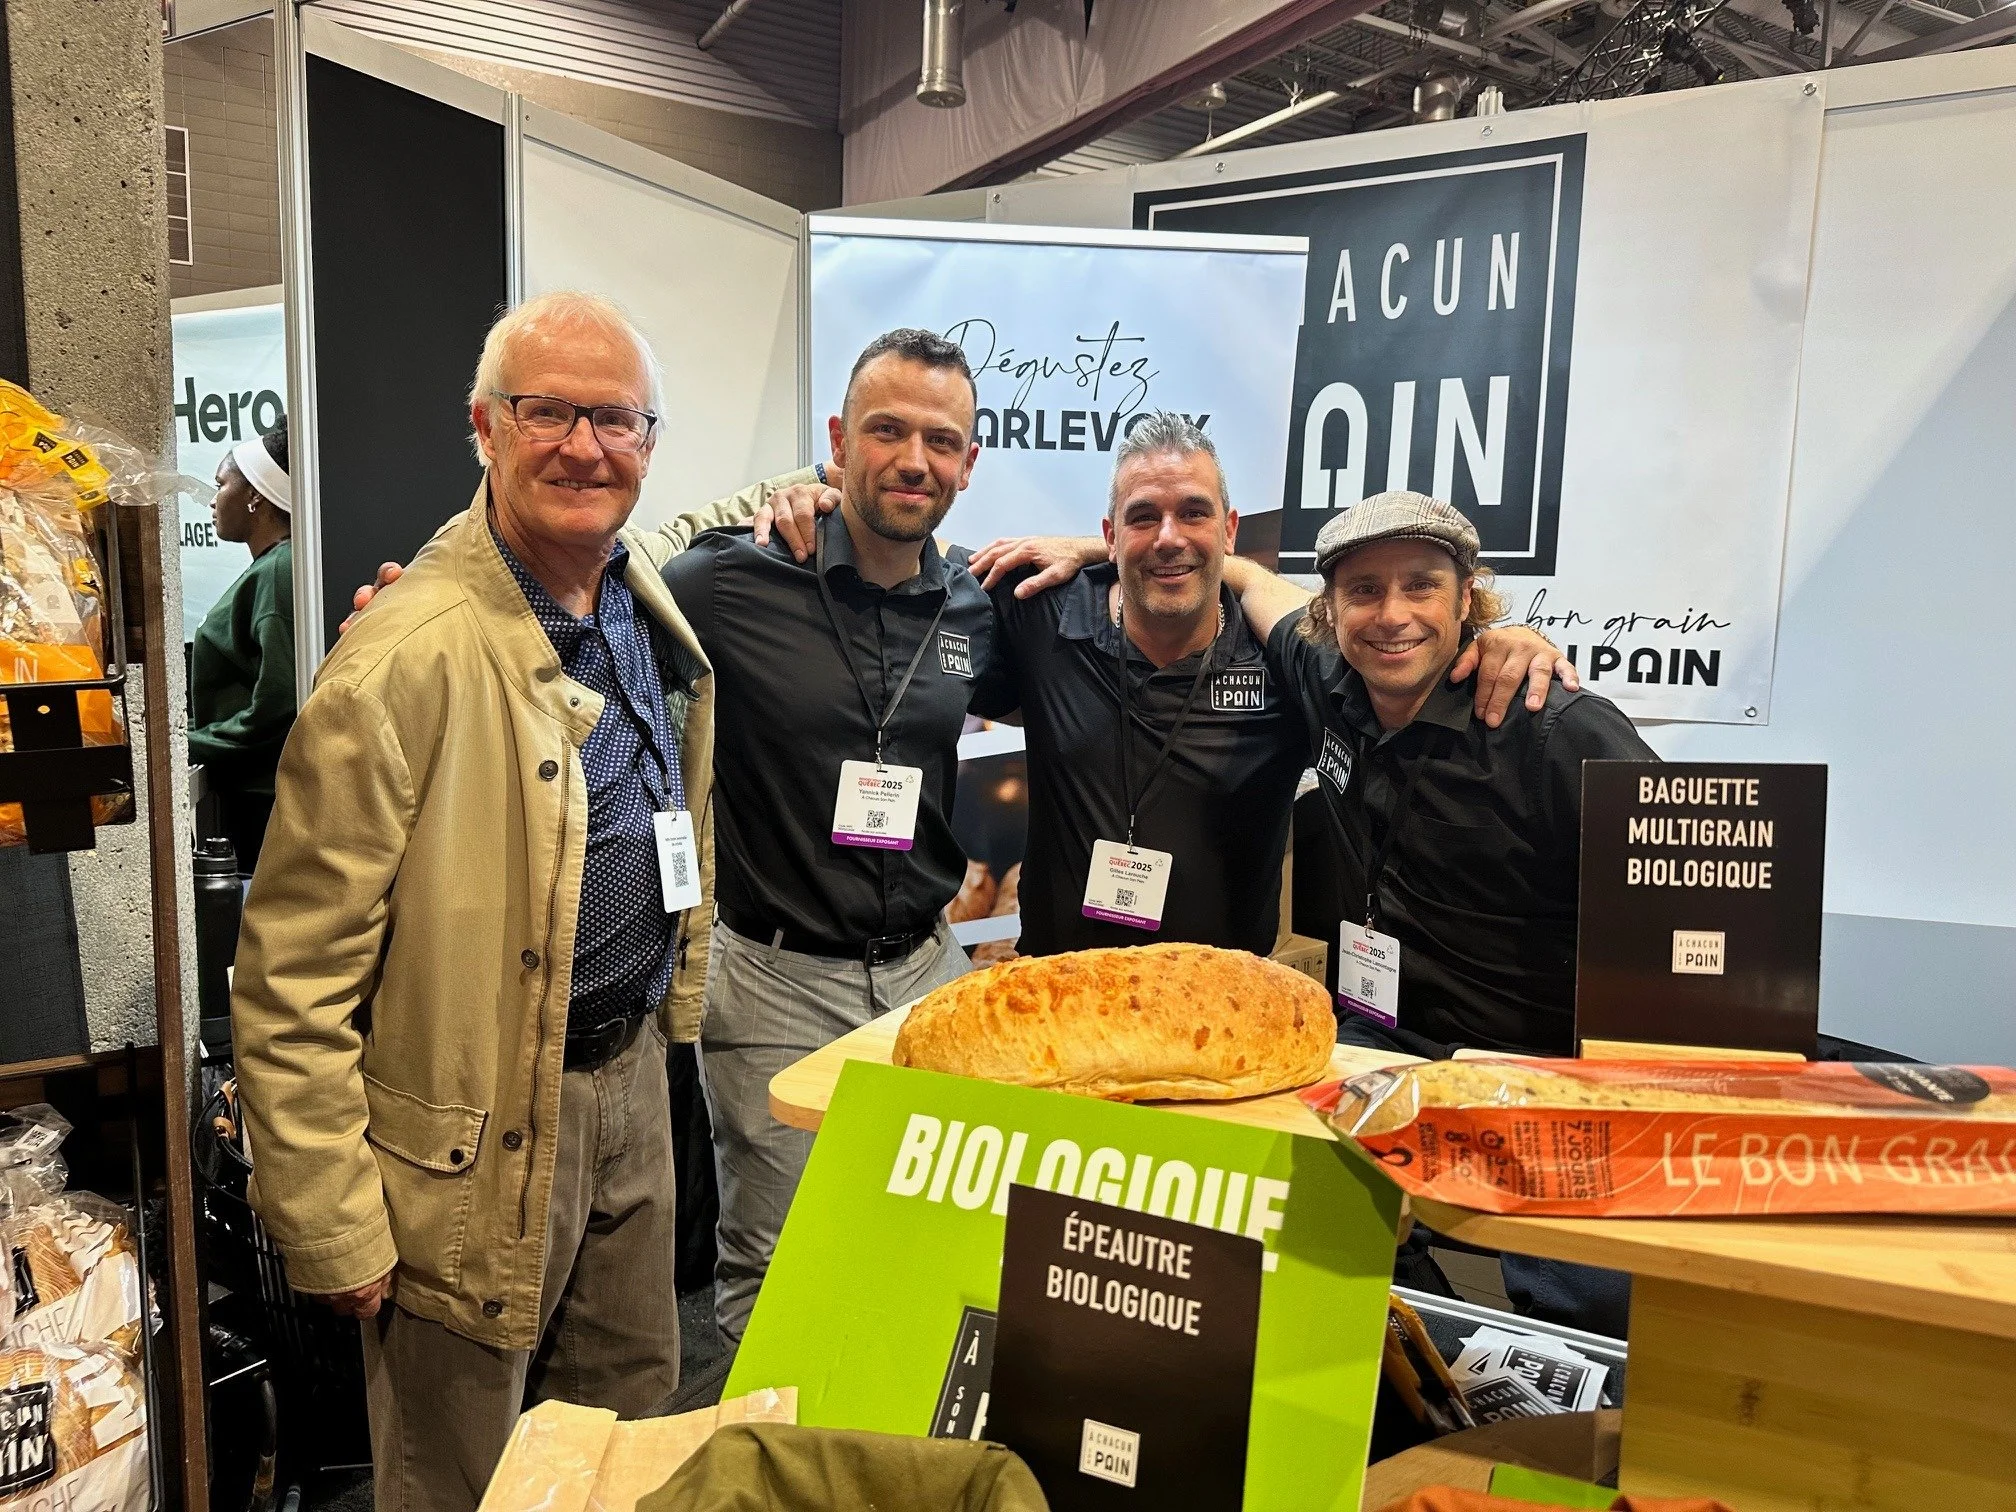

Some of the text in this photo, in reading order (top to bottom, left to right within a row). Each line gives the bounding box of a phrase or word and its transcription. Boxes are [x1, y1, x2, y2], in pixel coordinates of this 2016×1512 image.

[1327, 232, 1521, 324] ACUN
[944, 318, 1160, 420] Dégustez
[975, 407, 1211, 452] ARLEV
[1301, 376, 1511, 509] AIN
[1526, 588, 1731, 648] bon grain
[1222, 675, 1261, 685] CHACUN
[1589, 645, 1722, 687] PAIN
[1223, 690, 1260, 707] PAIN
[881, 780, 903, 790] 2025
[1638, 776, 1760, 806] BAGUETTE
[1628, 817, 1774, 848] MULTIGRAIN
[1131, 861, 1153, 872] 2025
[1627, 858, 1773, 890] BIOLOGIQUE
[1369, 946, 1386, 960] 2025
[1685, 953, 1718, 967] PAIN
[1568, 1135, 1588, 1198] JOURS
[1662, 1131, 1722, 1188] LE
[1739, 1132, 1865, 1188] BON
[1063, 1210, 1194, 1281] ÉPEAUTRE
[1046, 1264, 1202, 1337] BIOLOGIQUE
[963, 1329, 980, 1366] À
[0, 1434, 46, 1477] IN
[1094, 1451, 1130, 1476] PAIN
